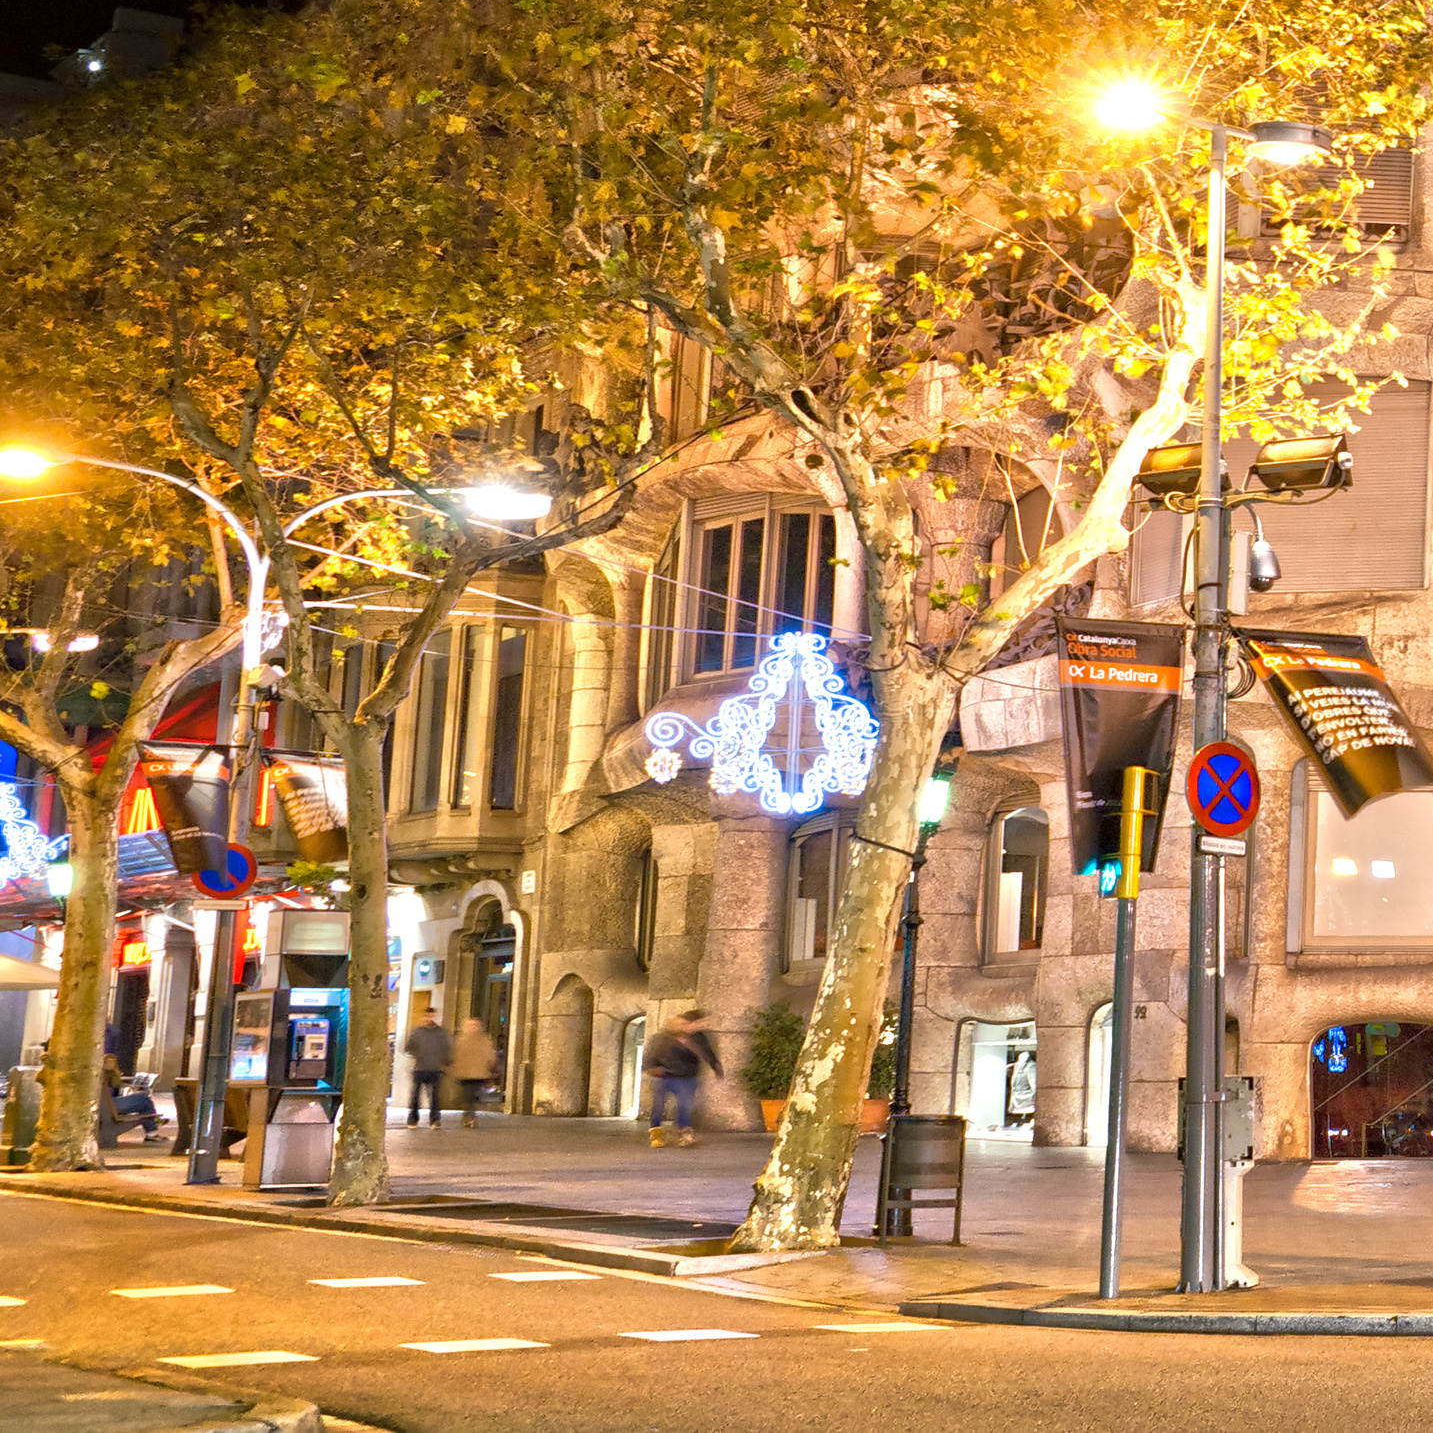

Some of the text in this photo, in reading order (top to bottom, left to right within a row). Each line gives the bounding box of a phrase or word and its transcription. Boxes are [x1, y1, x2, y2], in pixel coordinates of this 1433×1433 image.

[1078, 634, 1137, 646] CatalunyaCaixa
[1067, 642, 1137, 659] Obra Social
[1090, 666, 1105, 679] La
[1108, 667, 1158, 683] Pedrera
[1308, 697, 1351, 709] VEIES
[1352, 697, 1371, 706] LA
[1336, 729, 1358, 741] EN
[1323, 742, 1348, 764] CAP
[1351, 738, 1373, 750] DE
